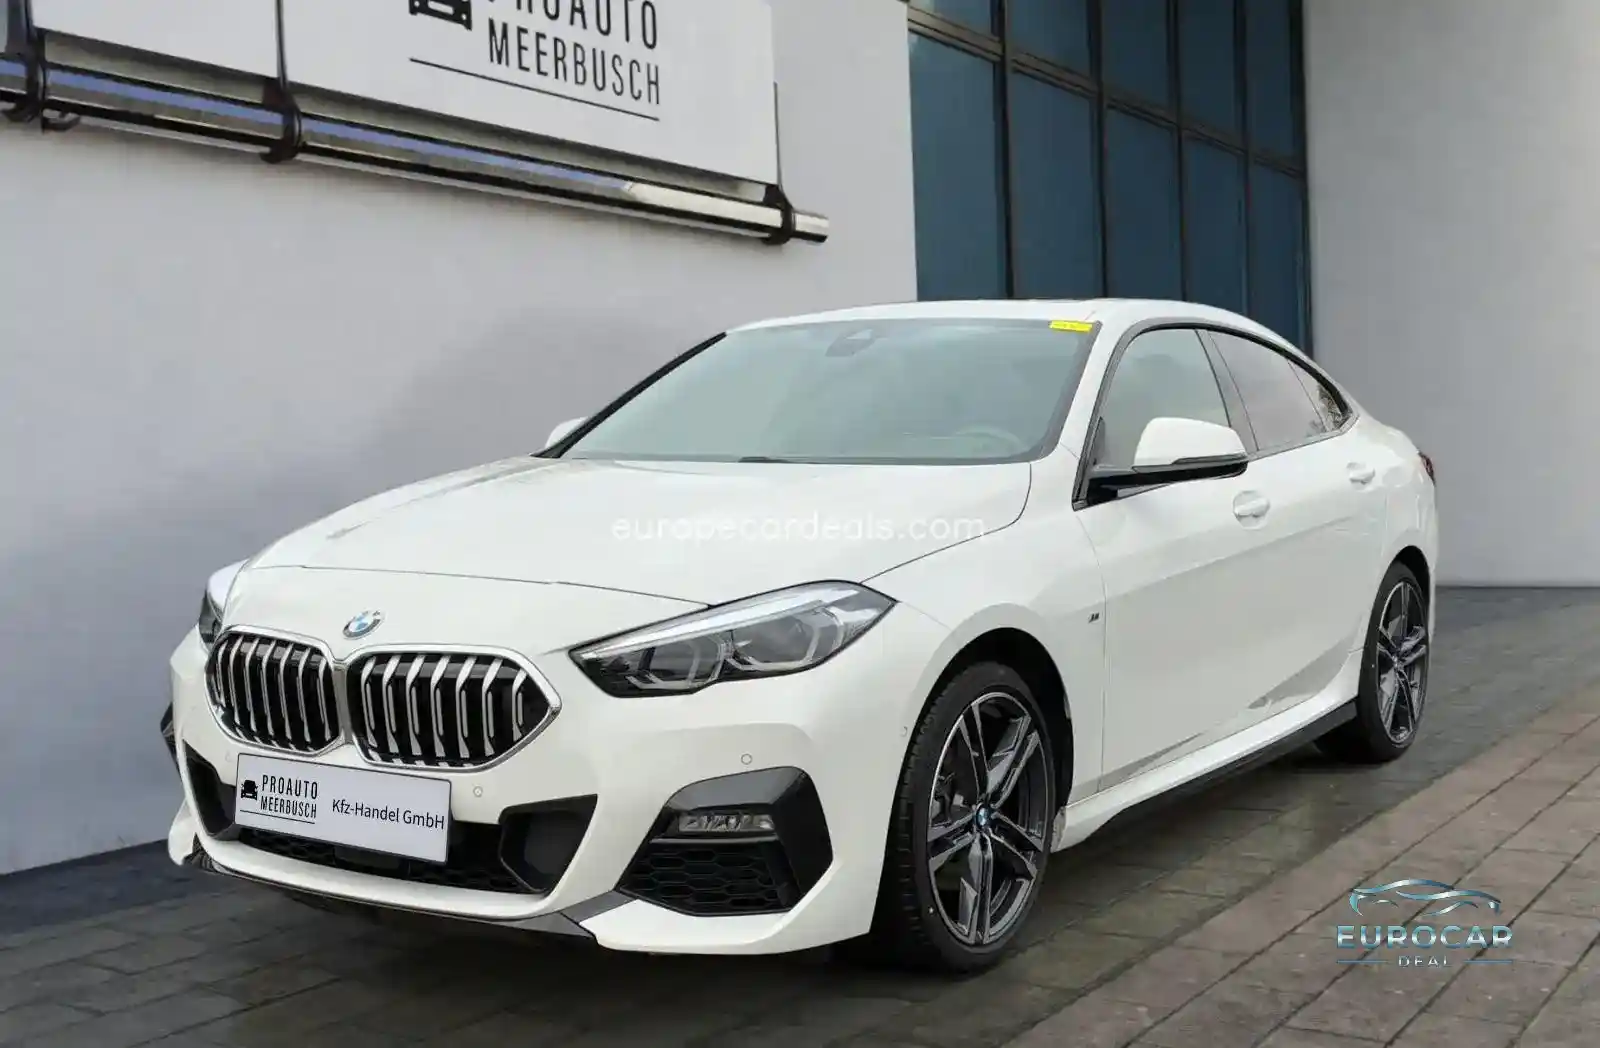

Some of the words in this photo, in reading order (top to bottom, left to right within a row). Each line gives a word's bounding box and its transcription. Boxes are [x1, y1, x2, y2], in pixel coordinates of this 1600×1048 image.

[487, 0, 657, 50] AUTO
[488, 17, 660, 105] MEERBUSCH
[262, 774, 318, 800] PROAUTO
[260, 798, 317, 819] MEERBUSCH
[332, 799, 399, 823] Kfz-Handel
[403, 810, 445, 830] GmbH
